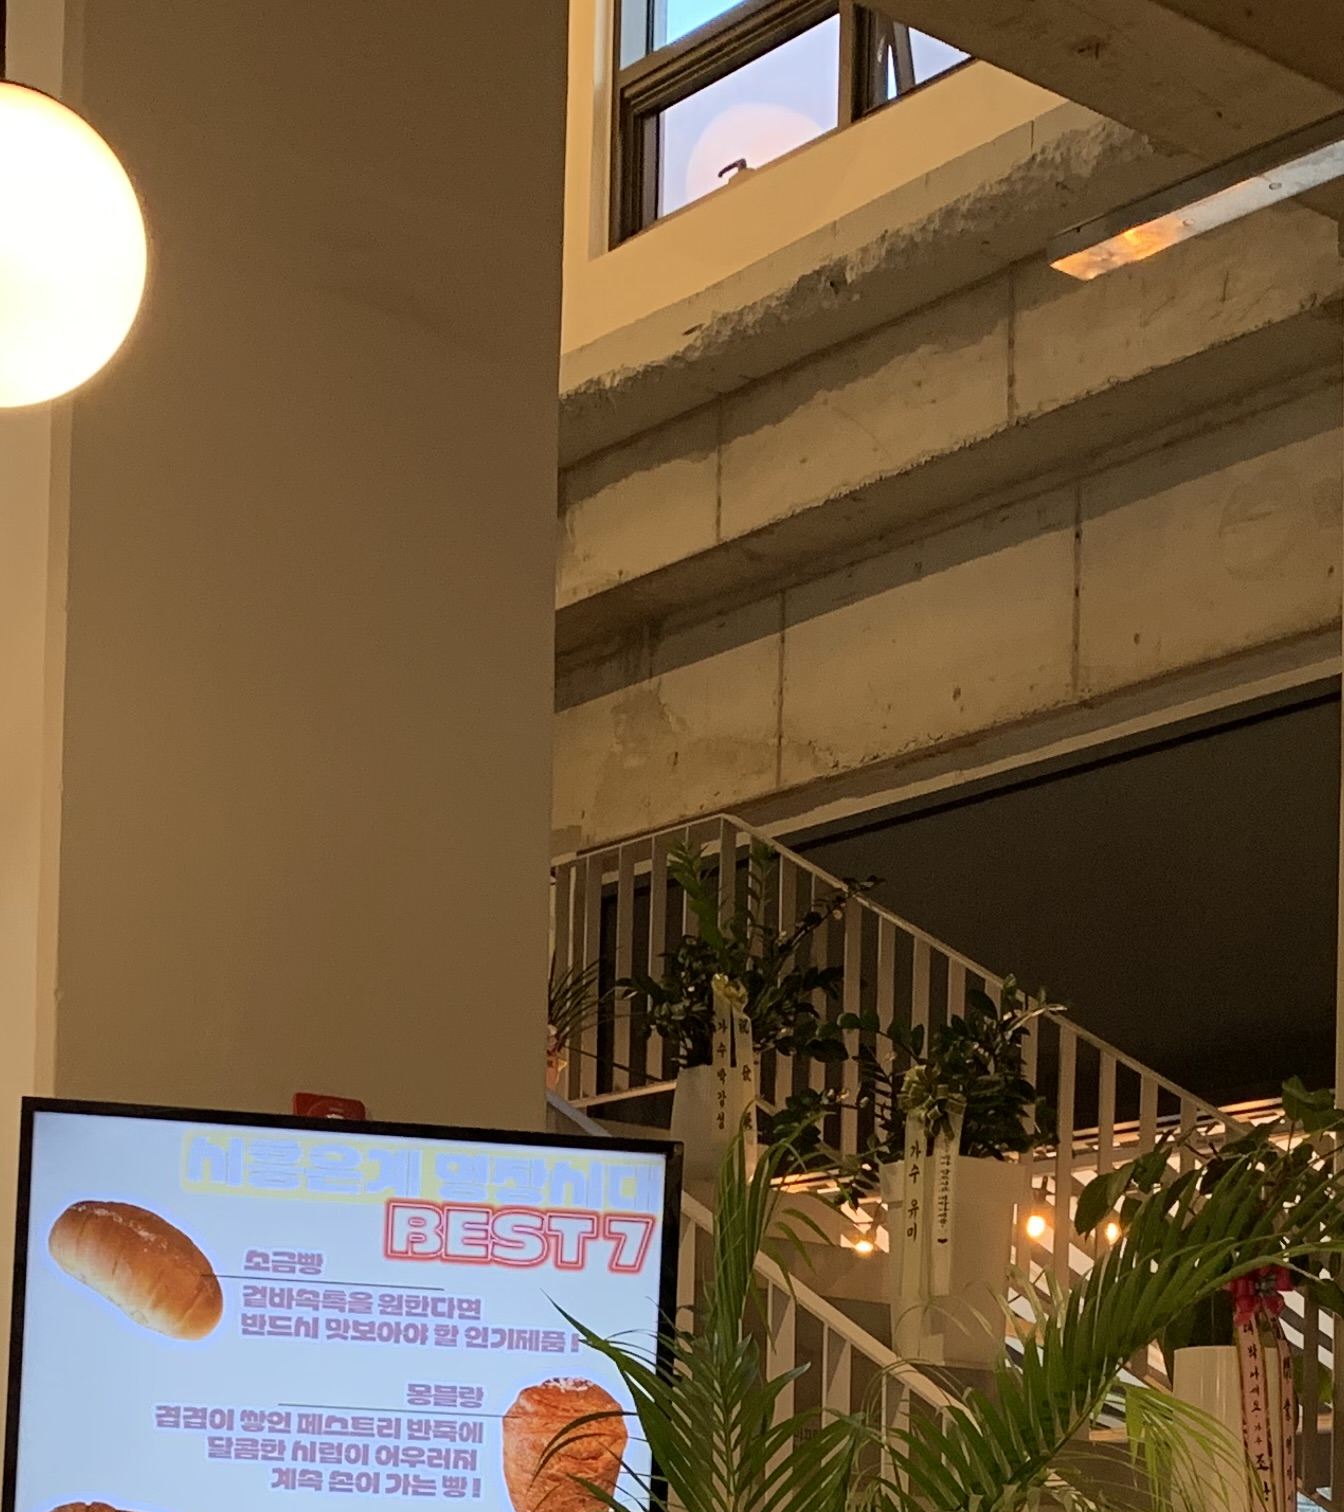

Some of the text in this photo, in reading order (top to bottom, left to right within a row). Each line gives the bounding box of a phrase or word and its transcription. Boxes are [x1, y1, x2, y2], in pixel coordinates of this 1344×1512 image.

[186, 1135, 655, 1213] 시흥은계 명장시대
[906, 1140, 922, 1243] 가수 유미
[384, 1200, 656, 1273] BEST 7
[243, 1249, 323, 1276] 소금빵
[377, 1292, 482, 1320] 원한다면
[241, 1312, 319, 1340] 반드시
[325, 1317, 429, 1346] 맛보아야
[433, 1323, 459, 1347] 할
[464, 1326, 567, 1353] 인기제품
[406, 1382, 485, 1408] 몽블랑
[156, 1405, 484, 1444] 겹겹이 쌓인 페스트리 반죽에
[207, 1436, 478, 1472] 달콤한 시럽이 어우러져
[271, 1467, 481, 1498] 계속 손이 가는 빵 !
